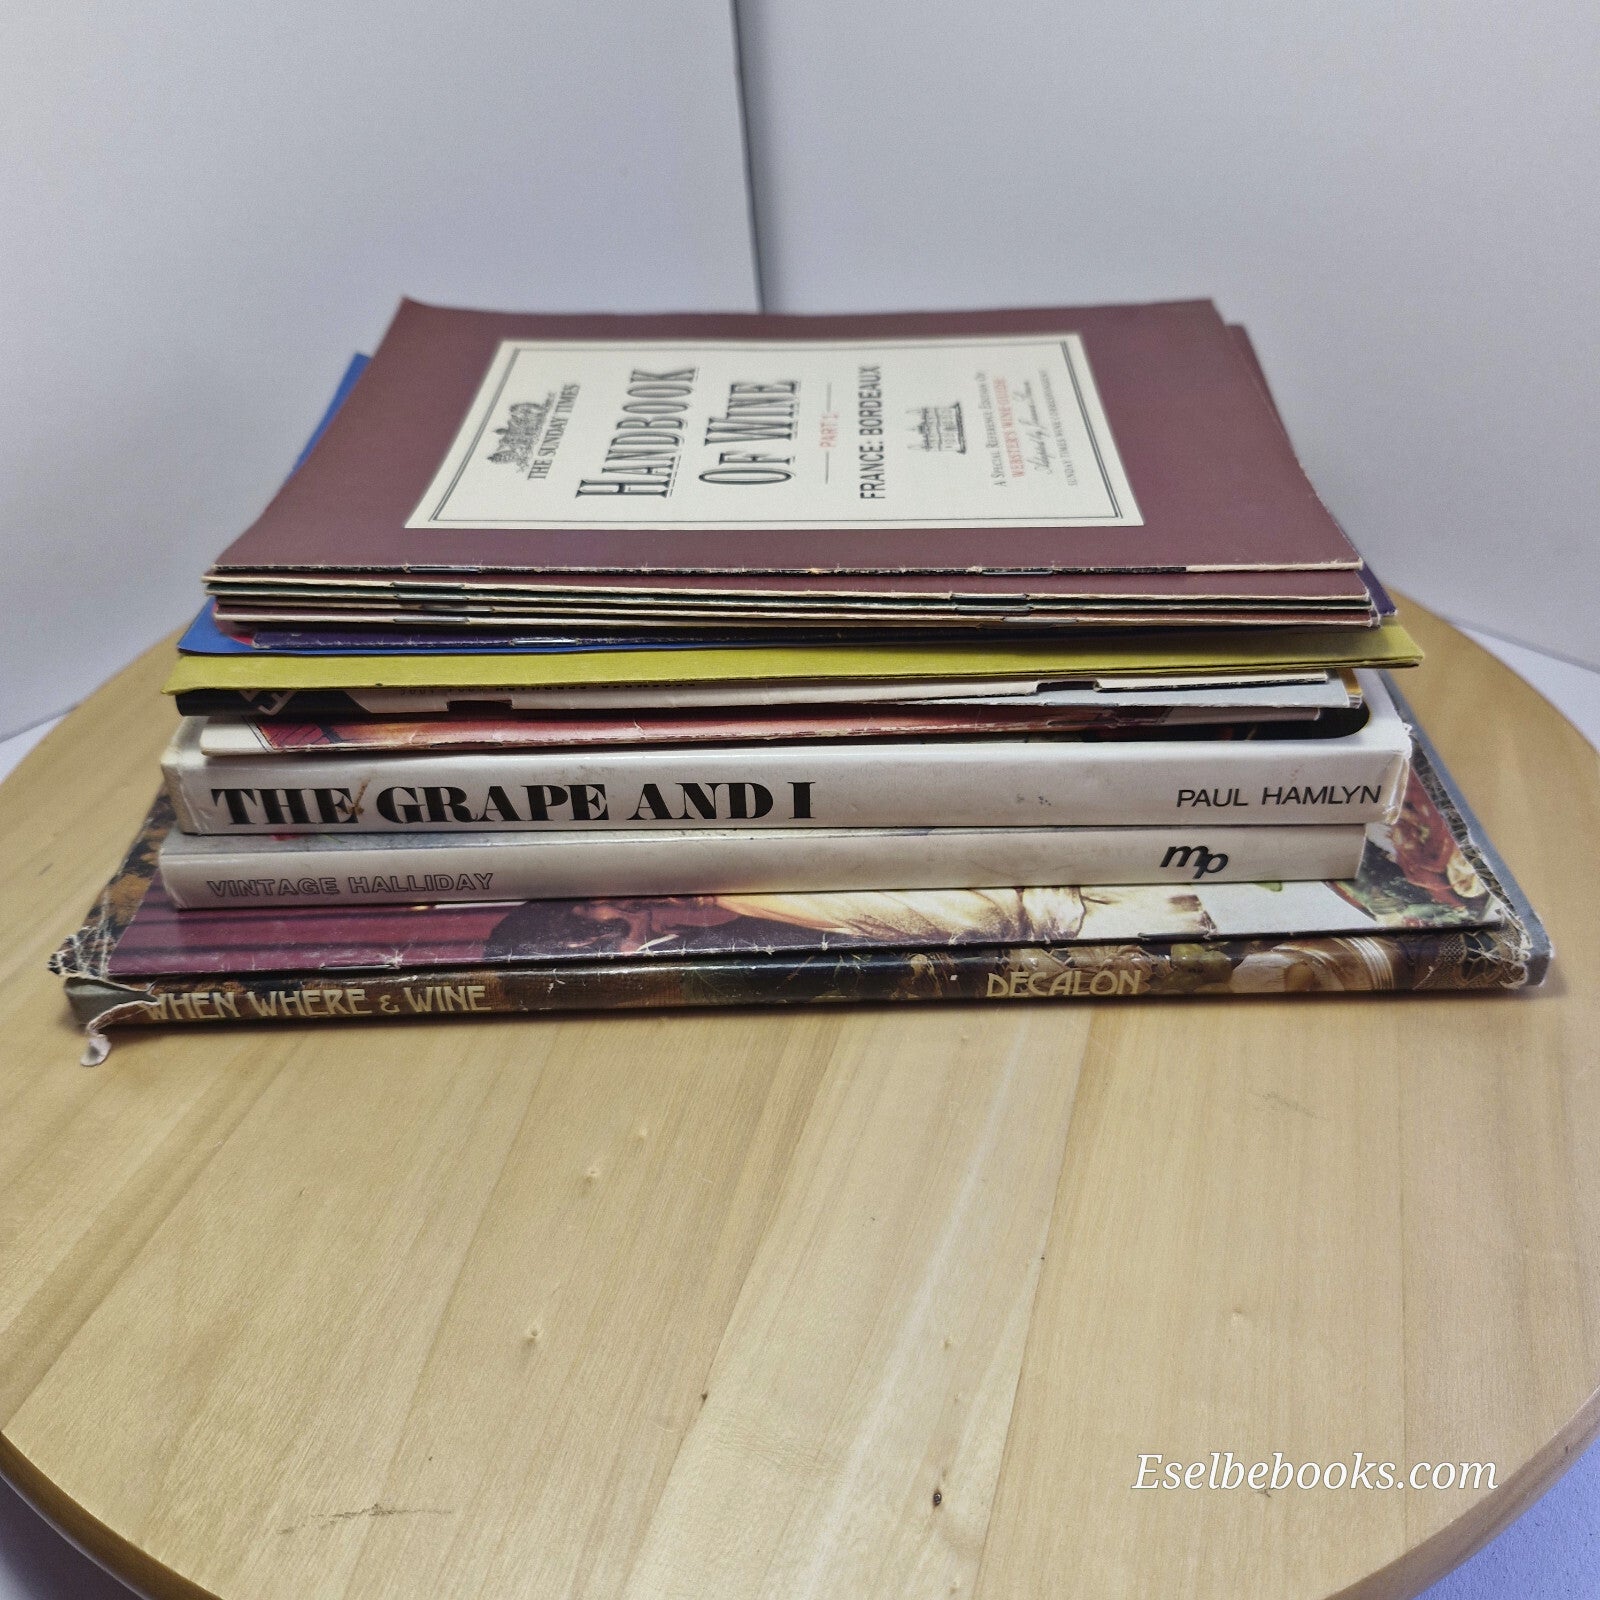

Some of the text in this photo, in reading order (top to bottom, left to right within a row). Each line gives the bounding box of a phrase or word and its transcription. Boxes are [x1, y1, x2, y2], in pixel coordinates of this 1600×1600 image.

[527, 383, 581, 480] THE SUNDAY TIMES
[575, 366, 700, 499] HANDBOOK
[699, 380, 799, 486] OF WINE
[819, 422, 837, 449] PART
[858, 365, 886, 500] FRANCE: BORDEAUX
[211, 781, 816, 827] THE GRAPE AND I
[1176, 784, 1383, 809] PAUL HAMLYN
[206, 872, 496, 899] VINTAGE HALLIDAY
[248, 988, 367, 1018] WHERE
[401, 984, 493, 1014] WINE
[986, 971, 1142, 998] DECALON
